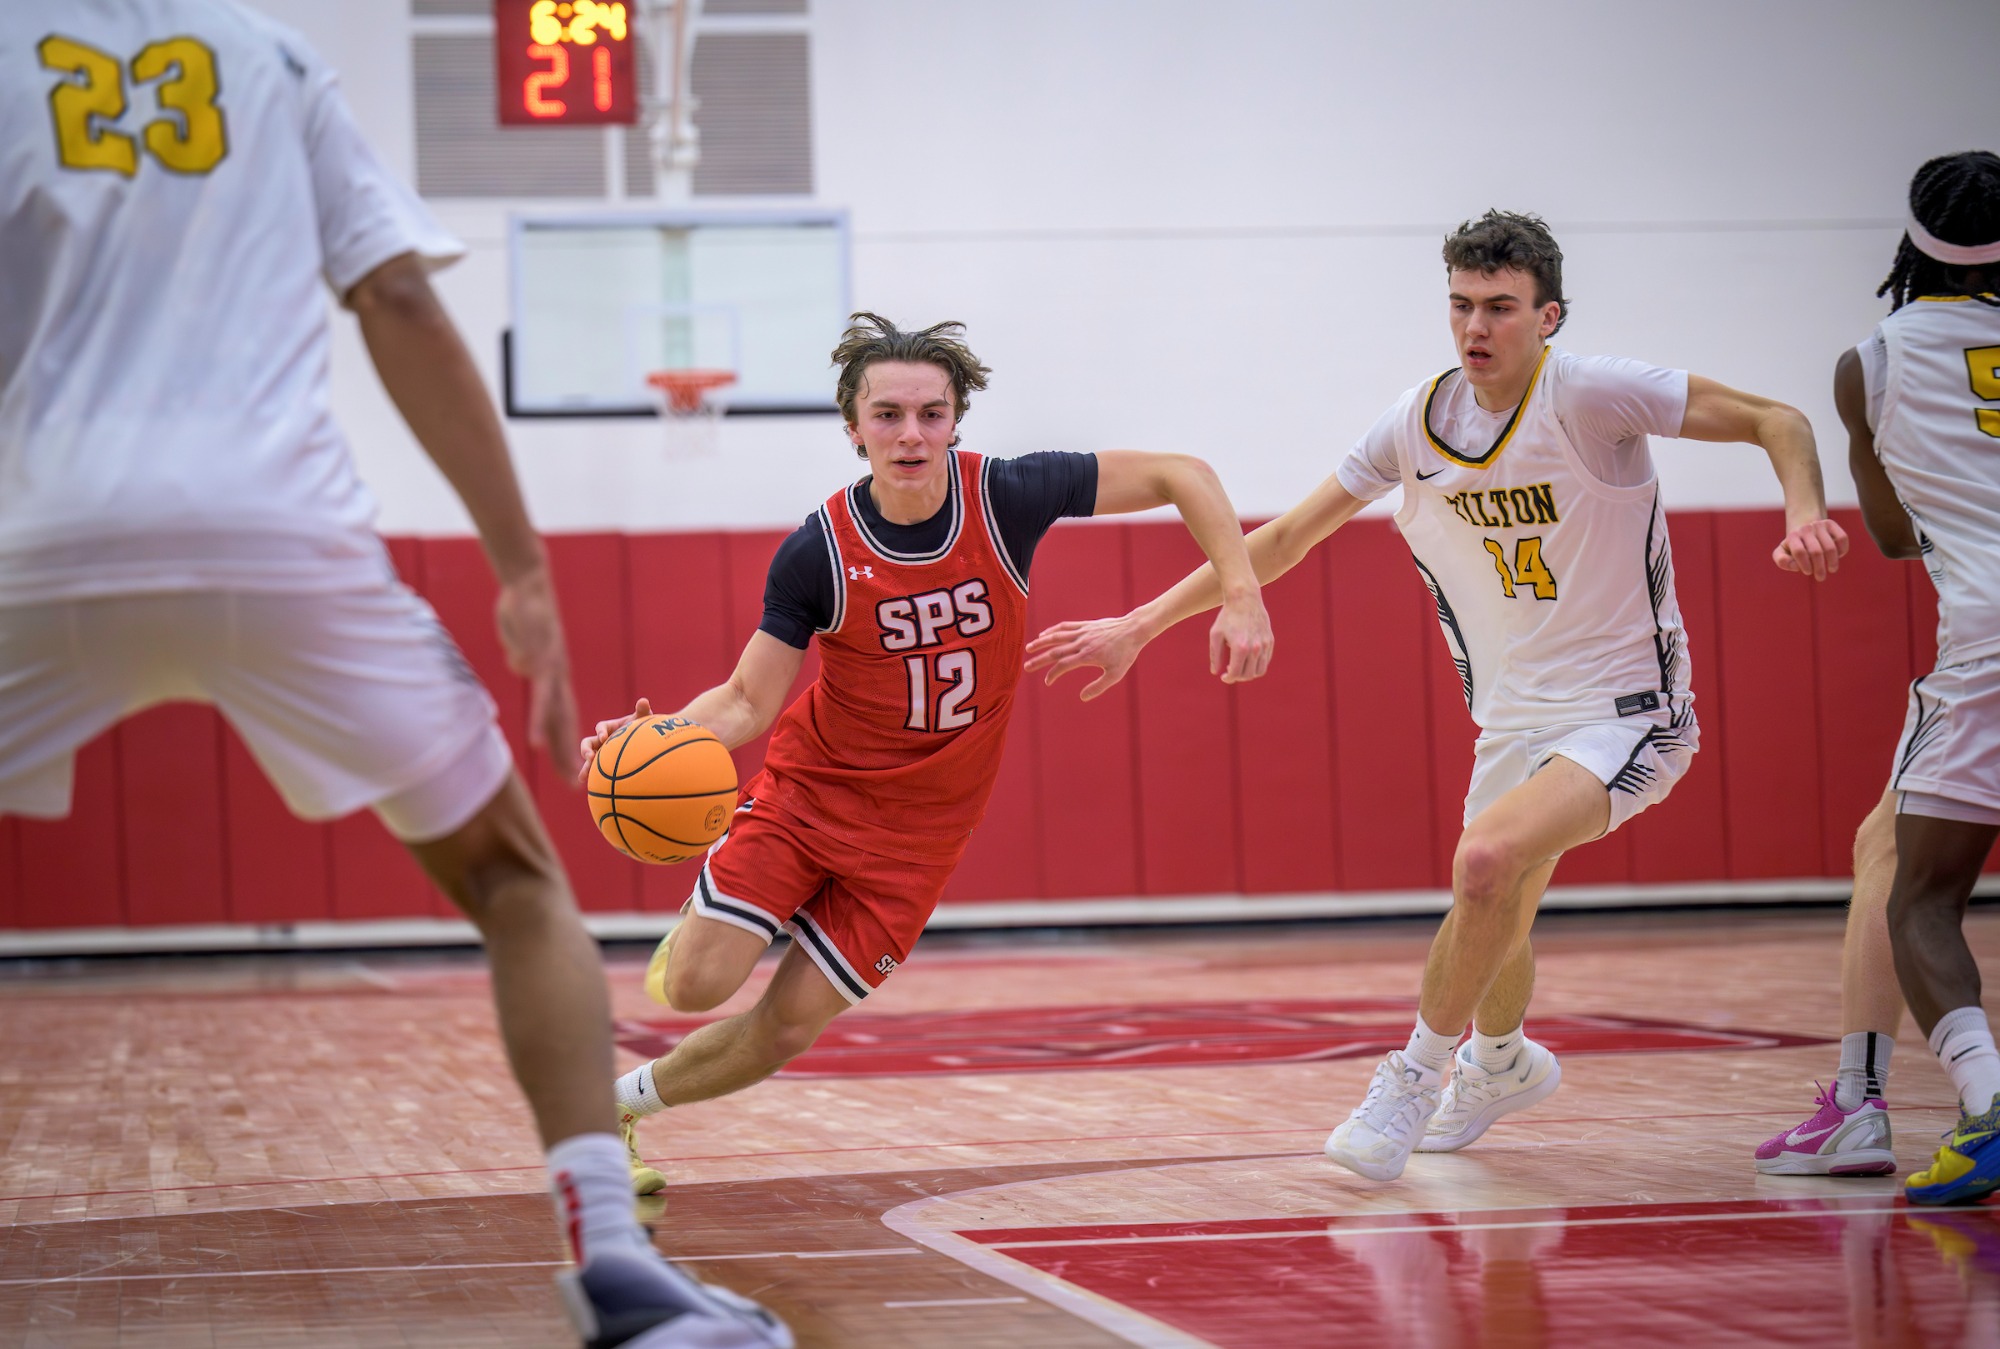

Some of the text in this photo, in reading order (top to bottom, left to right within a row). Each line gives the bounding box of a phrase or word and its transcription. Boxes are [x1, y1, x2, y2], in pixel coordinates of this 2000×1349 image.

[530, 0, 627, 45] 6:24
[36, 34, 229, 179] 23
[523, 44, 612, 118] 21
[1483, 536, 1557, 601] 14
[875, 578, 995, 653] SPS
[902, 647, 978, 733] 12
[874, 953, 899, 978] SP
